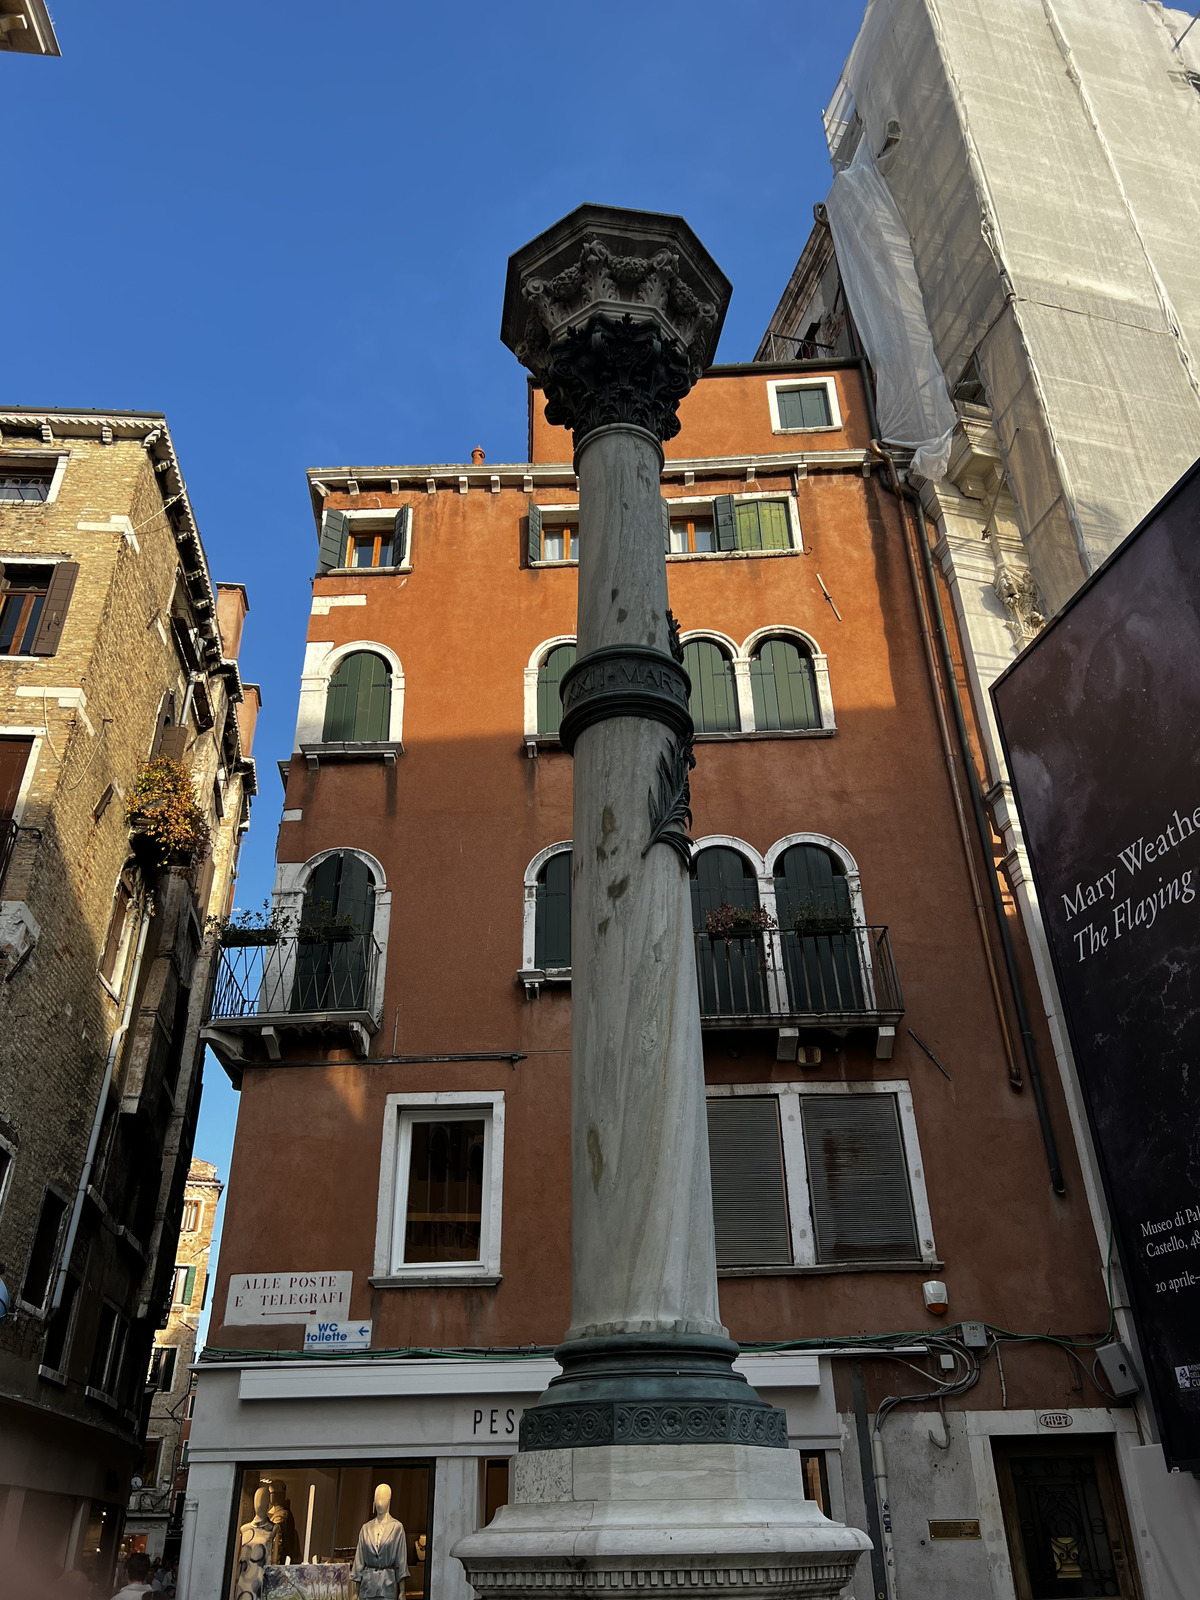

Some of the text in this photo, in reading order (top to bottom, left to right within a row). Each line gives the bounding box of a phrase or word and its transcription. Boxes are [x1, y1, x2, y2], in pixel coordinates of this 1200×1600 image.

[1060, 868, 1117, 922] Mary
[1073, 869, 1196, 963] The Flaying
[1140, 1219, 1173, 1238] Museo
[1174, 1211, 1185, 1228] di
[1146, 1235, 1188, 1258] Castello,
[242, 1275, 337, 1290] ALLE POSTE
[1155, 1281, 1167, 1294] 20
[235, 1291, 344, 1307] E TELEGRAFI
[318, 1323, 338, 1332] WC
[306, 1332, 347, 1342] toilette
